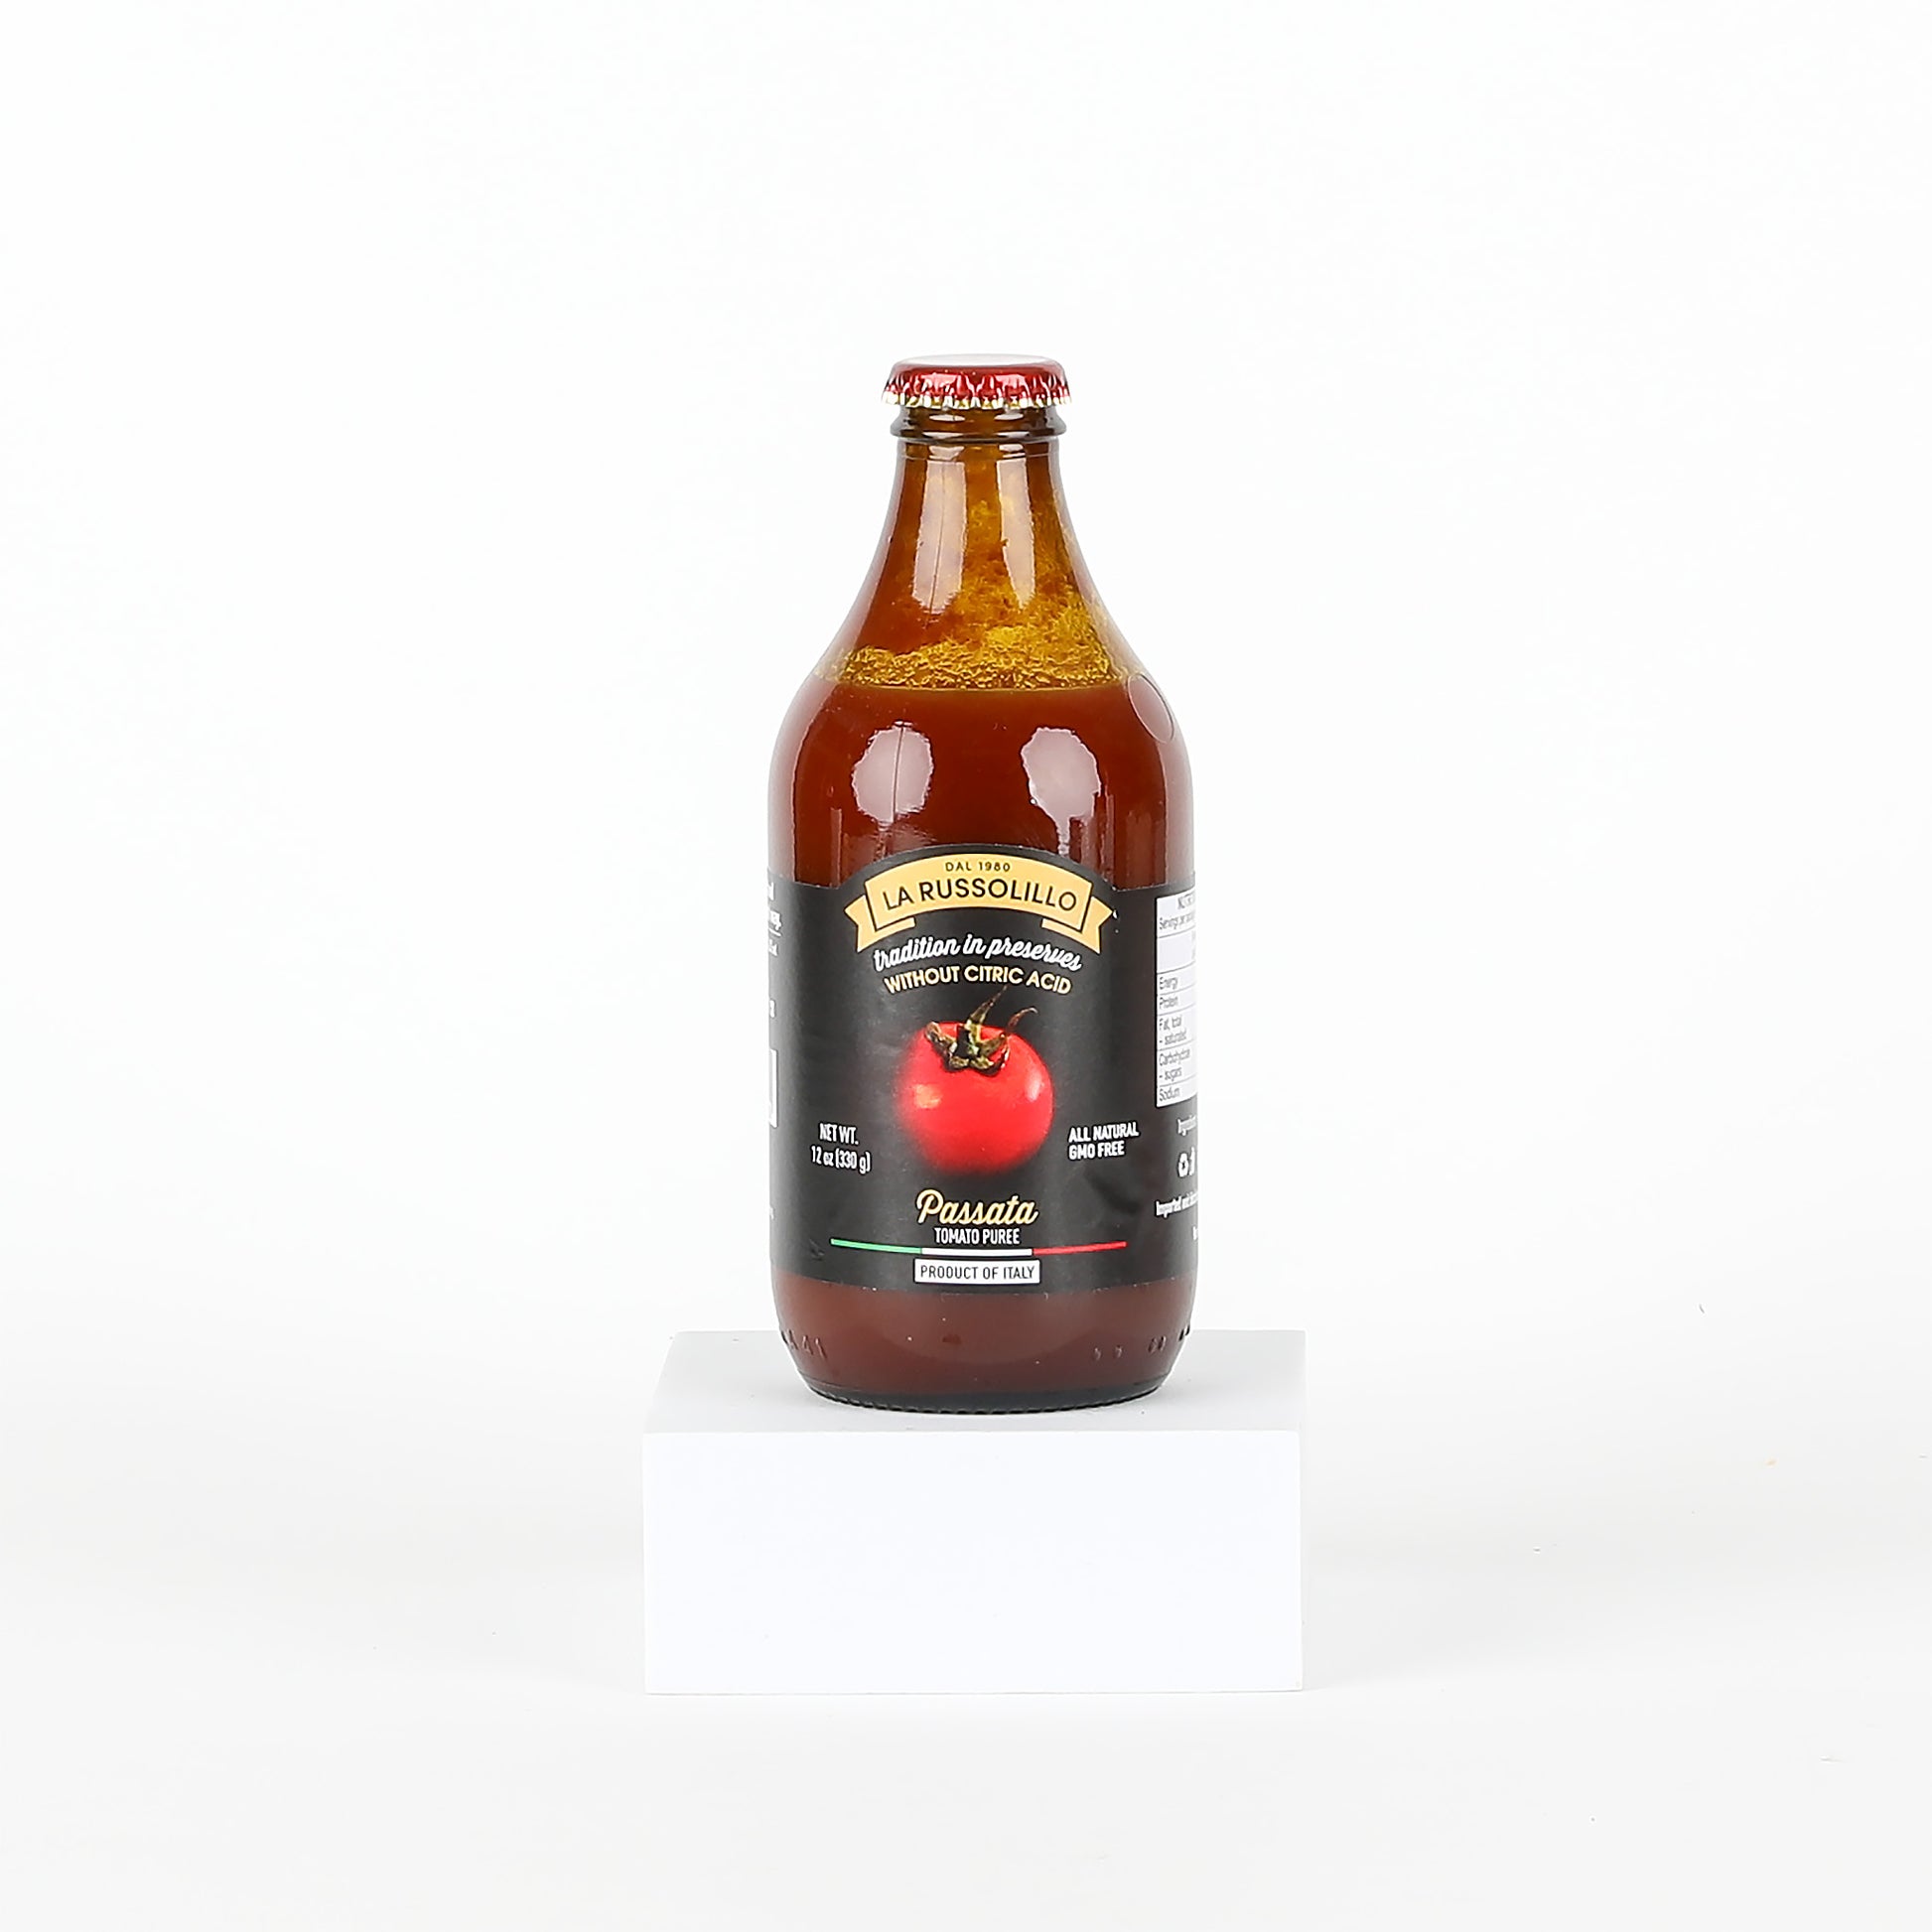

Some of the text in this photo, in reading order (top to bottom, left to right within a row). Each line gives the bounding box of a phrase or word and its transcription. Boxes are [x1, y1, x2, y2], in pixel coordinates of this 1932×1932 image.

[945, 862, 1011, 872] DAL 1980
[882, 878, 1077, 911] LA RUSSOLILLO
[873, 934, 1083, 972] tradition in preserves
[884, 964, 1072, 995] WITHOUT CITRIC ACID
[819, 1123, 859, 1145] NET WT.
[1068, 1122, 1140, 1143] ALL NATURAL
[811, 1146, 871, 1173] 12 oz (330 g)
[1068, 1141, 1125, 1161] GMO FREE
[916, 1188, 1039, 1225] Passata
[933, 1227, 1021, 1245] TOMATO PUREE
[919, 1265, 1035, 1281] PRODUCT OF ITALY
